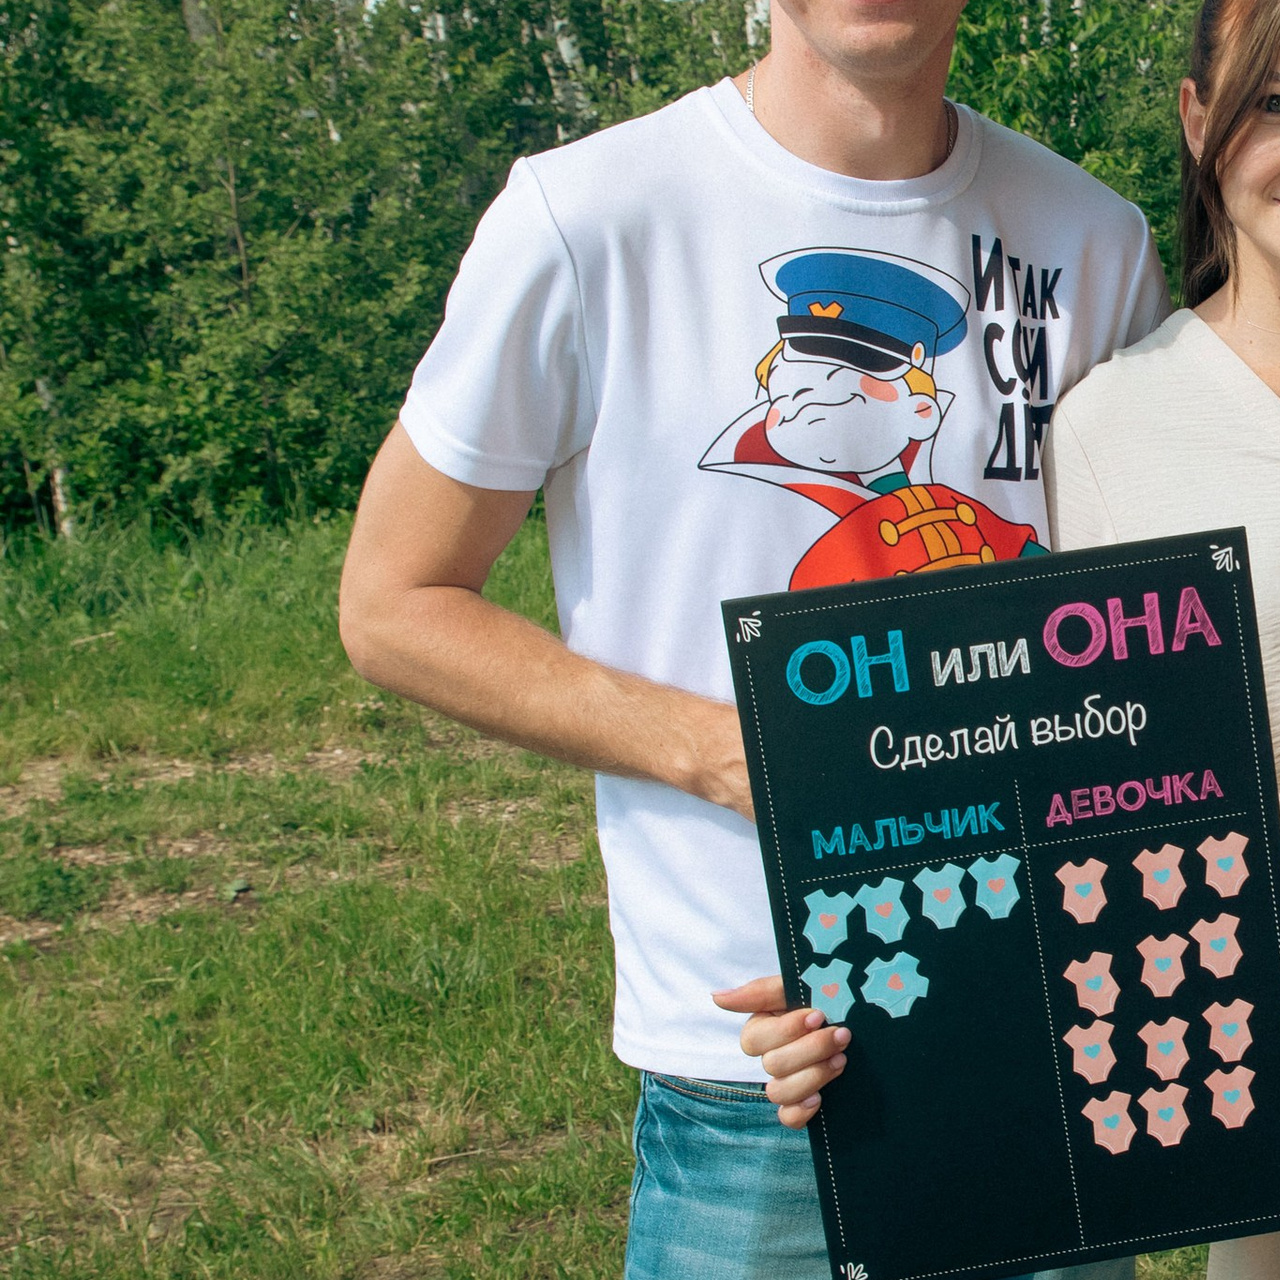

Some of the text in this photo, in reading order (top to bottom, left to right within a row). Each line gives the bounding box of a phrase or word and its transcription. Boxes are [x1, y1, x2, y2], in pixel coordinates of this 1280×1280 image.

[971, 233, 1005, 312] И
[786, 586, 1222, 706] ОН или ОНА
[869, 694, 1148, 771] Сделай выбор
[811, 801, 1006, 860] МАЛЬЧИК
[1046, 769, 1225, 828] ДЕВОЧКА
